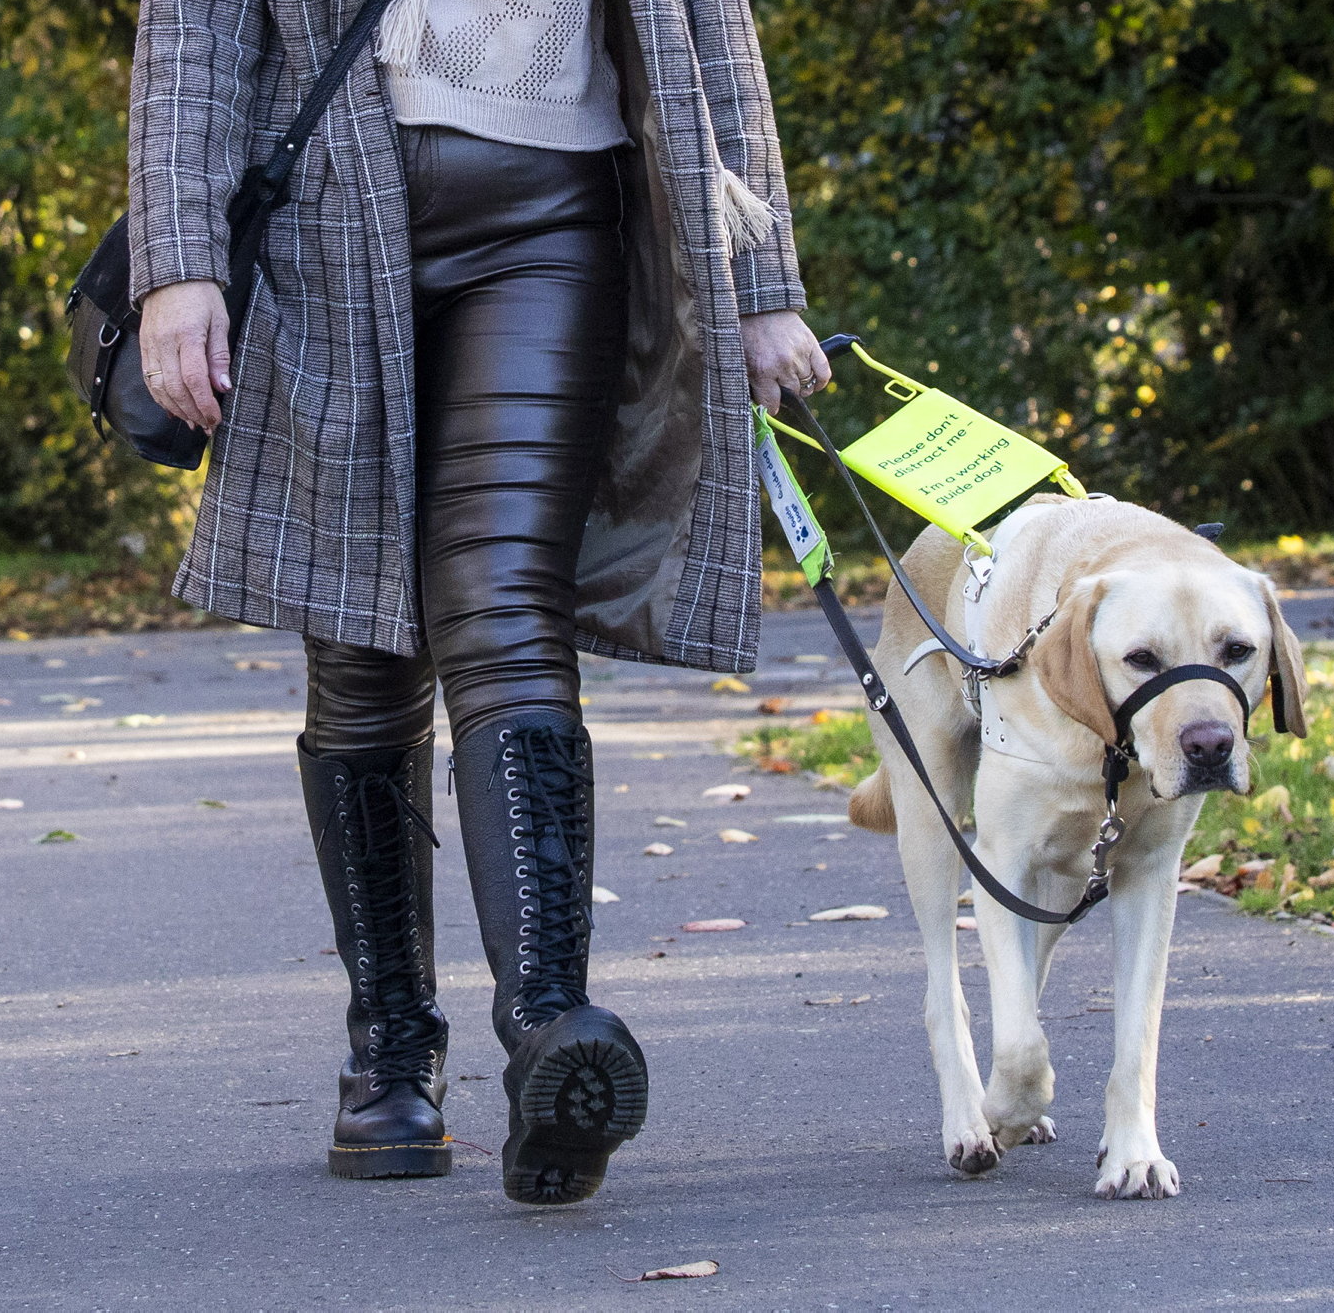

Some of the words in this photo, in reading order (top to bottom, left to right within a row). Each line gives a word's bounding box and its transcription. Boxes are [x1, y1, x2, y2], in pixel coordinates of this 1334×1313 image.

[762, 450, 773, 470] dog
[878, 442, 925, 470] Please
[926, 413, 959, 442] don't
[894, 446, 947, 478] distract
[946, 429, 967, 447] me
[772, 471, 783, 500] Guide
[918, 482, 944, 495] I'm
[956, 438, 1010, 476] working
[936, 483, 973, 506] guide
[974, 460, 1004, 483] dog!
